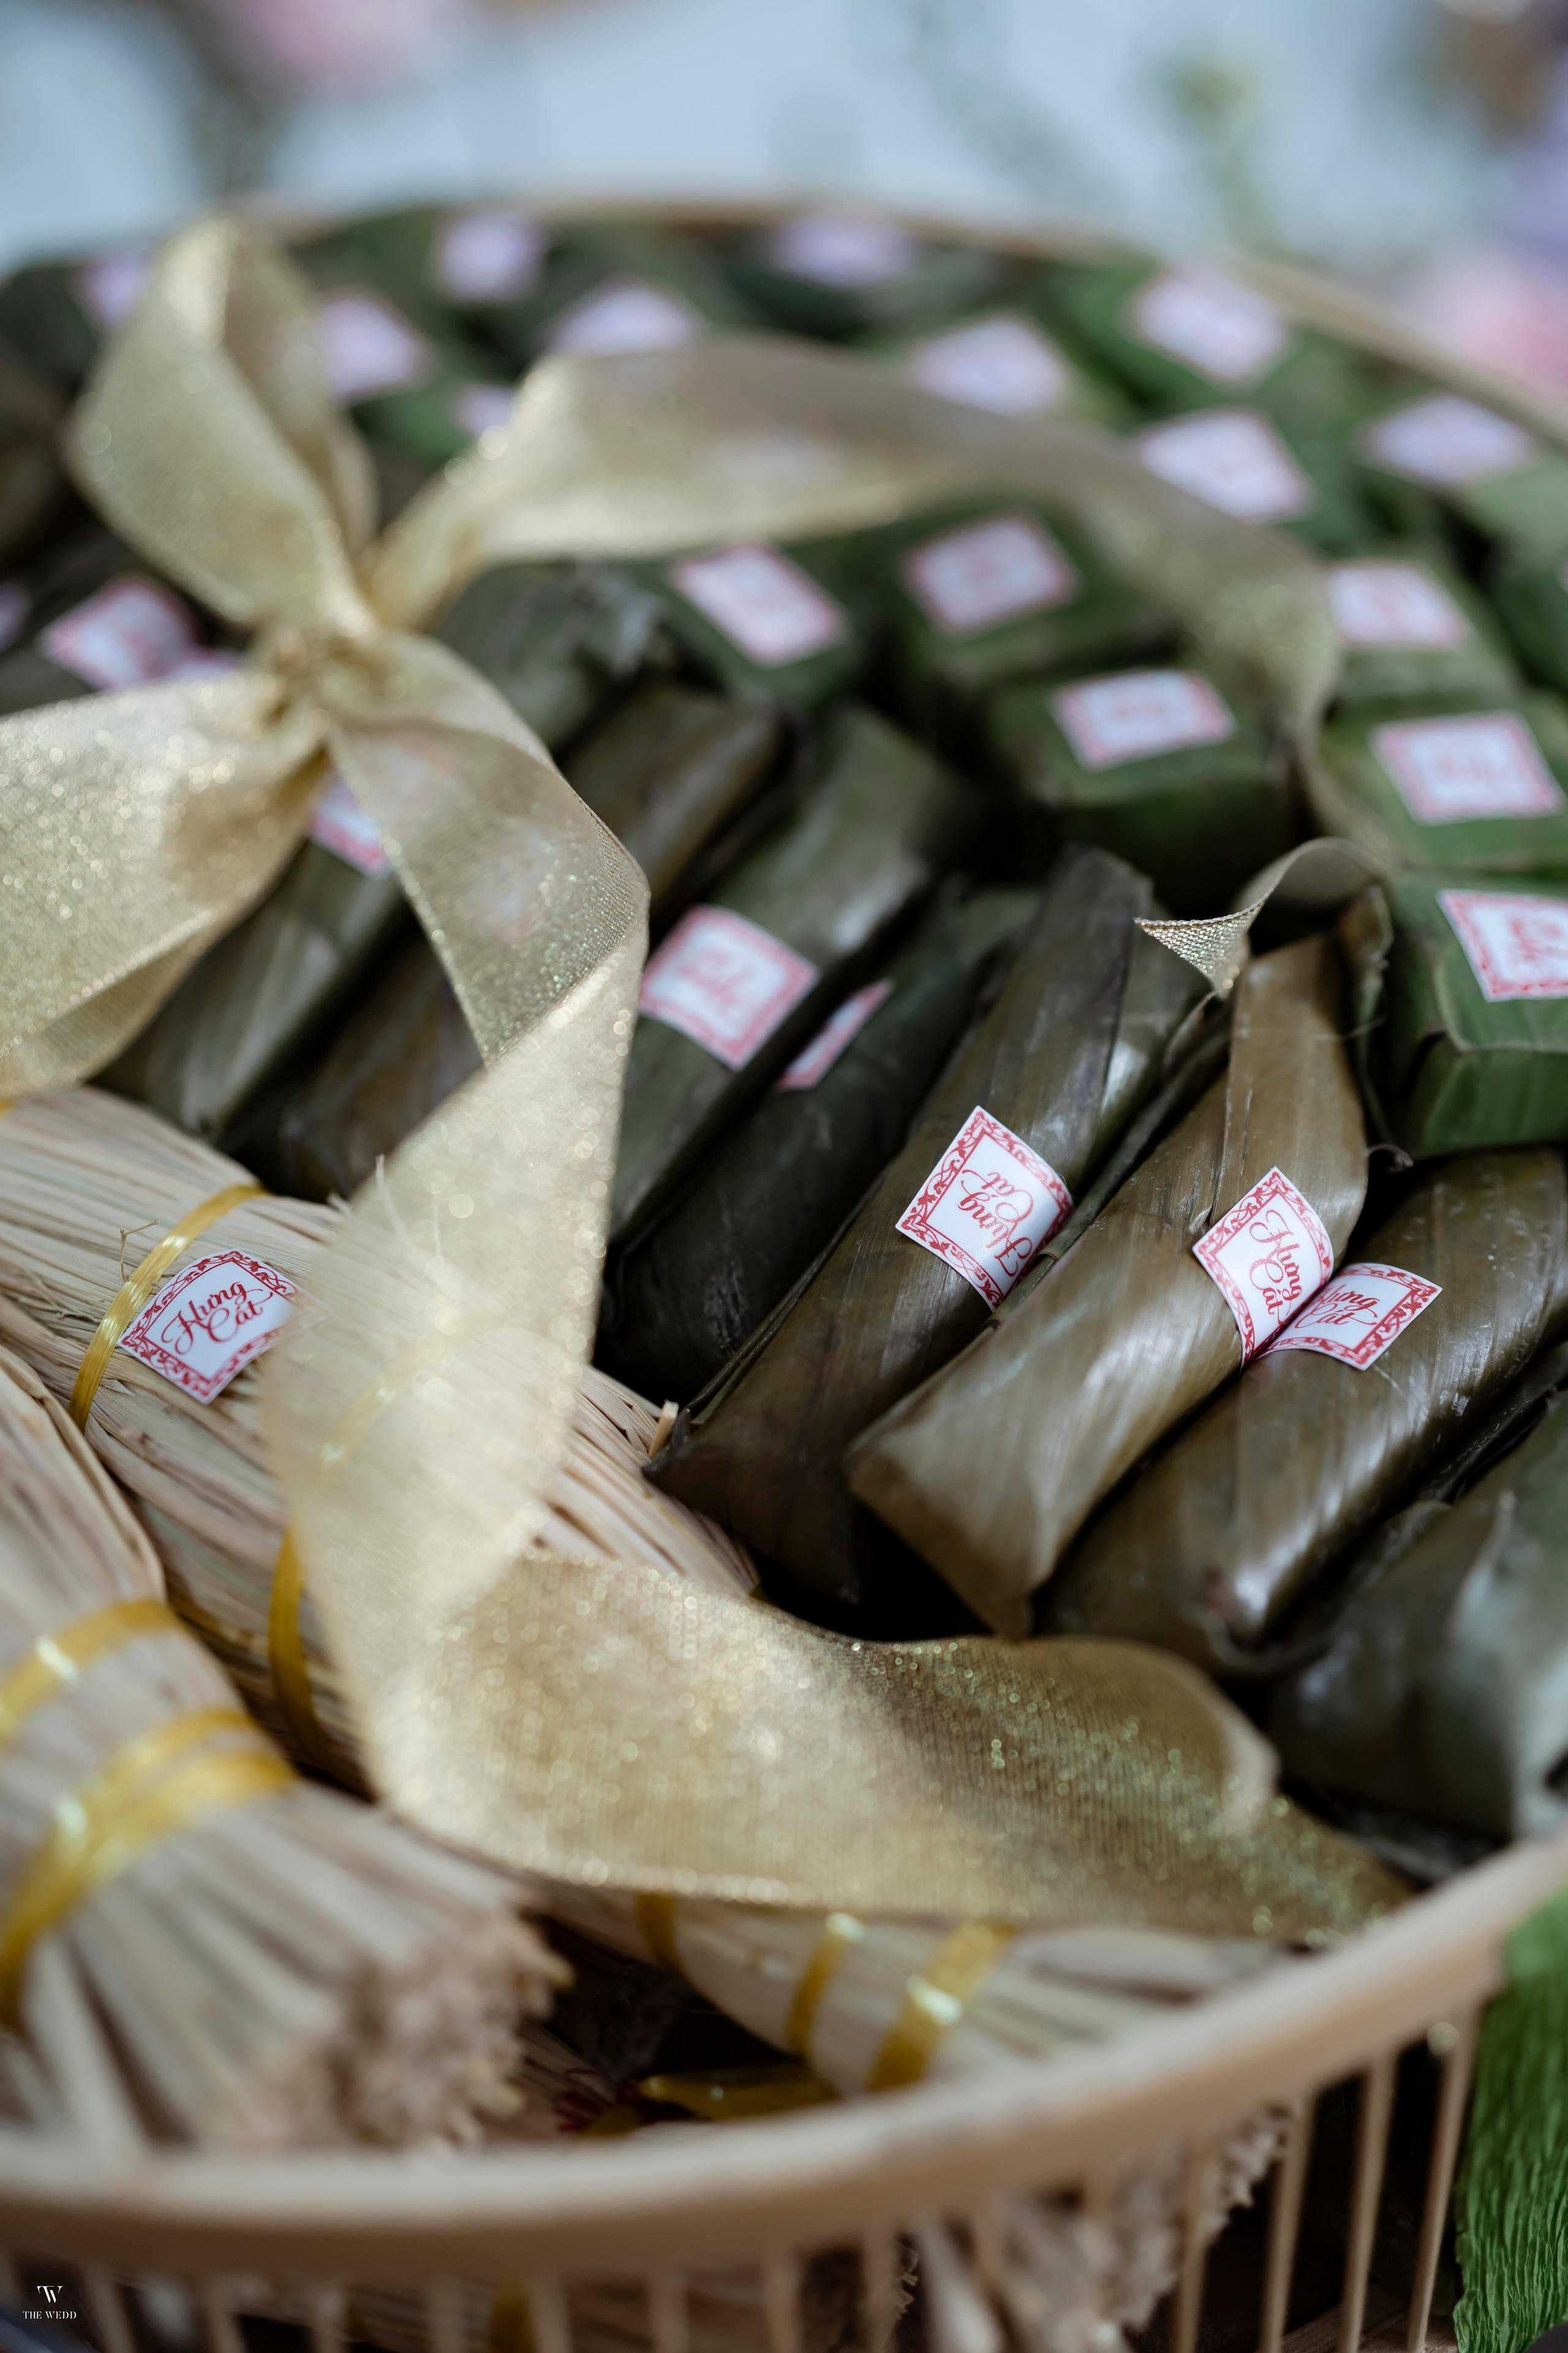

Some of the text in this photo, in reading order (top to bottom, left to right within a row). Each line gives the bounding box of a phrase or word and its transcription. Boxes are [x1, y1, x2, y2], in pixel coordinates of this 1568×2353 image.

[962, 1169, 1035, 1223] Cát
[206, 1291, 273, 1342] Cát
[1249, 1258, 1284, 1324] Cát
[1294, 1303, 1378, 1329] Cát
